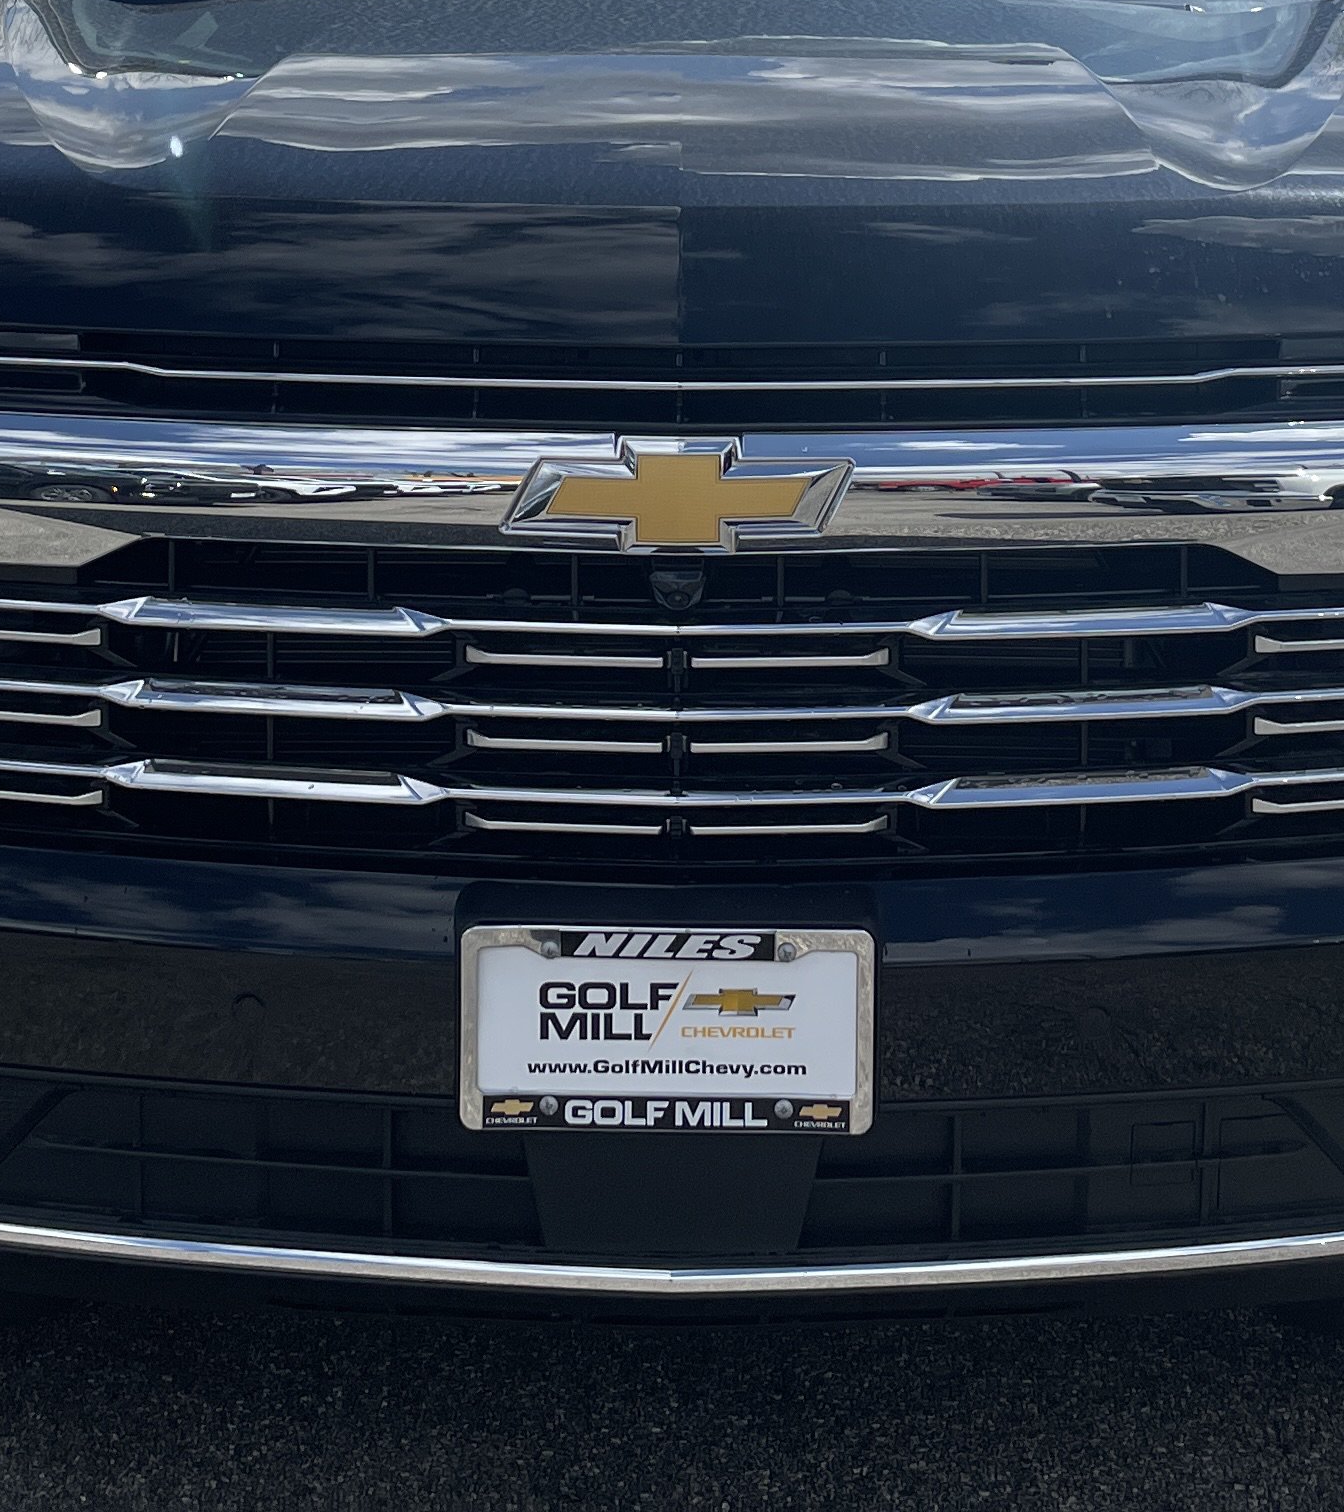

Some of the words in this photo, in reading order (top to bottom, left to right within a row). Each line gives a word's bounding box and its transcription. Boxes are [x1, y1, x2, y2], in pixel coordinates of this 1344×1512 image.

[574, 933, 762, 959] NILES
[538, 982, 679, 1010] GOLF
[539, 1012, 653, 1041] MILL
[680, 1026, 796, 1039] CHEVROLET
[527, 1059, 807, 1078] www.GolfMillChevy.com
[564, 1099, 670, 1127] GOLF
[674, 1100, 768, 1128] MILL
